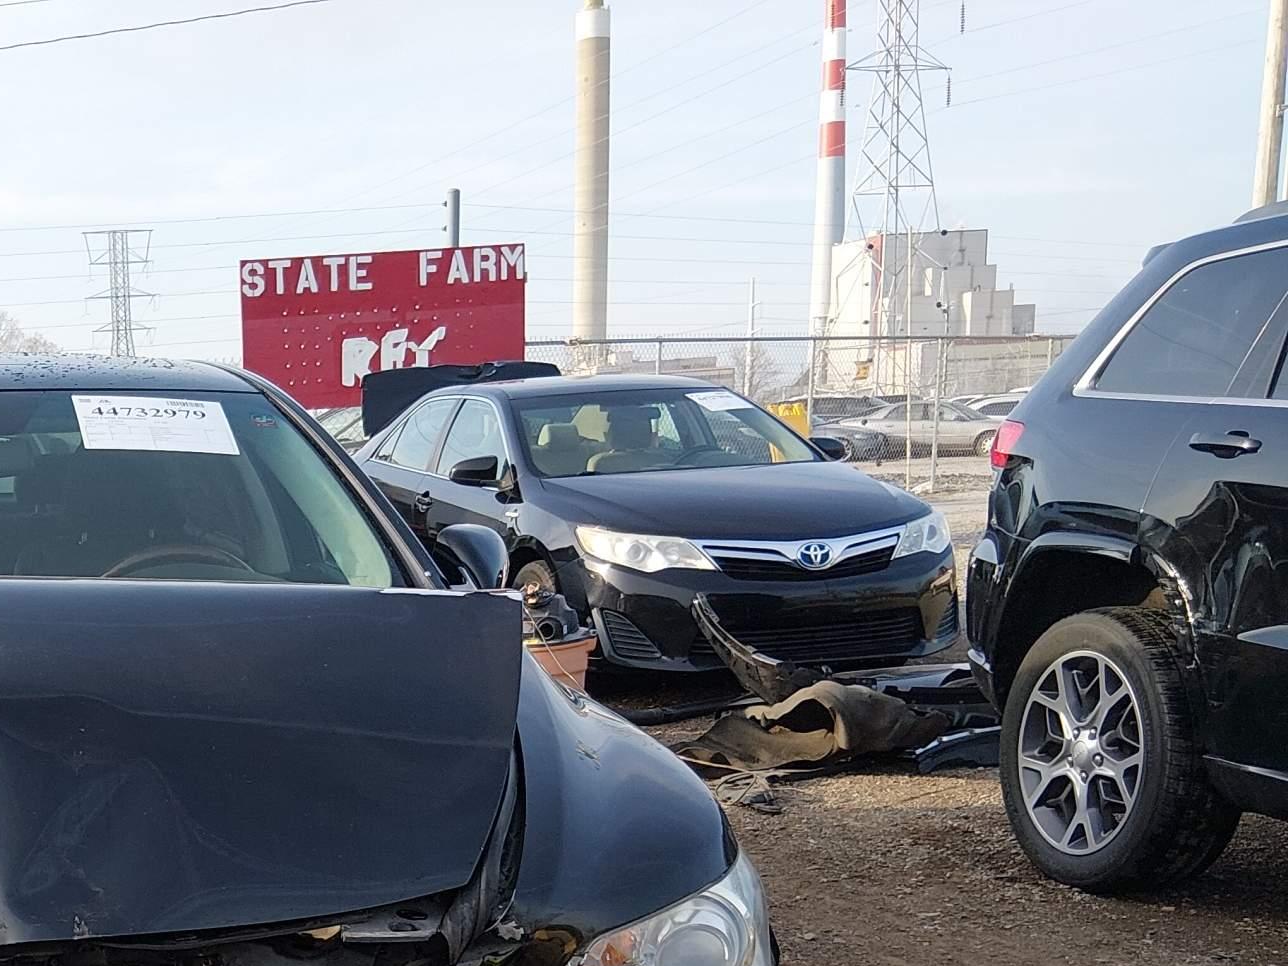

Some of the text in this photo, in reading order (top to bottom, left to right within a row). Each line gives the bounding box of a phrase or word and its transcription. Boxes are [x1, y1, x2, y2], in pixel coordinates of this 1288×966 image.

[241, 246, 524, 297] STATE FARM
[91, 406, 206, 420] 44732979
